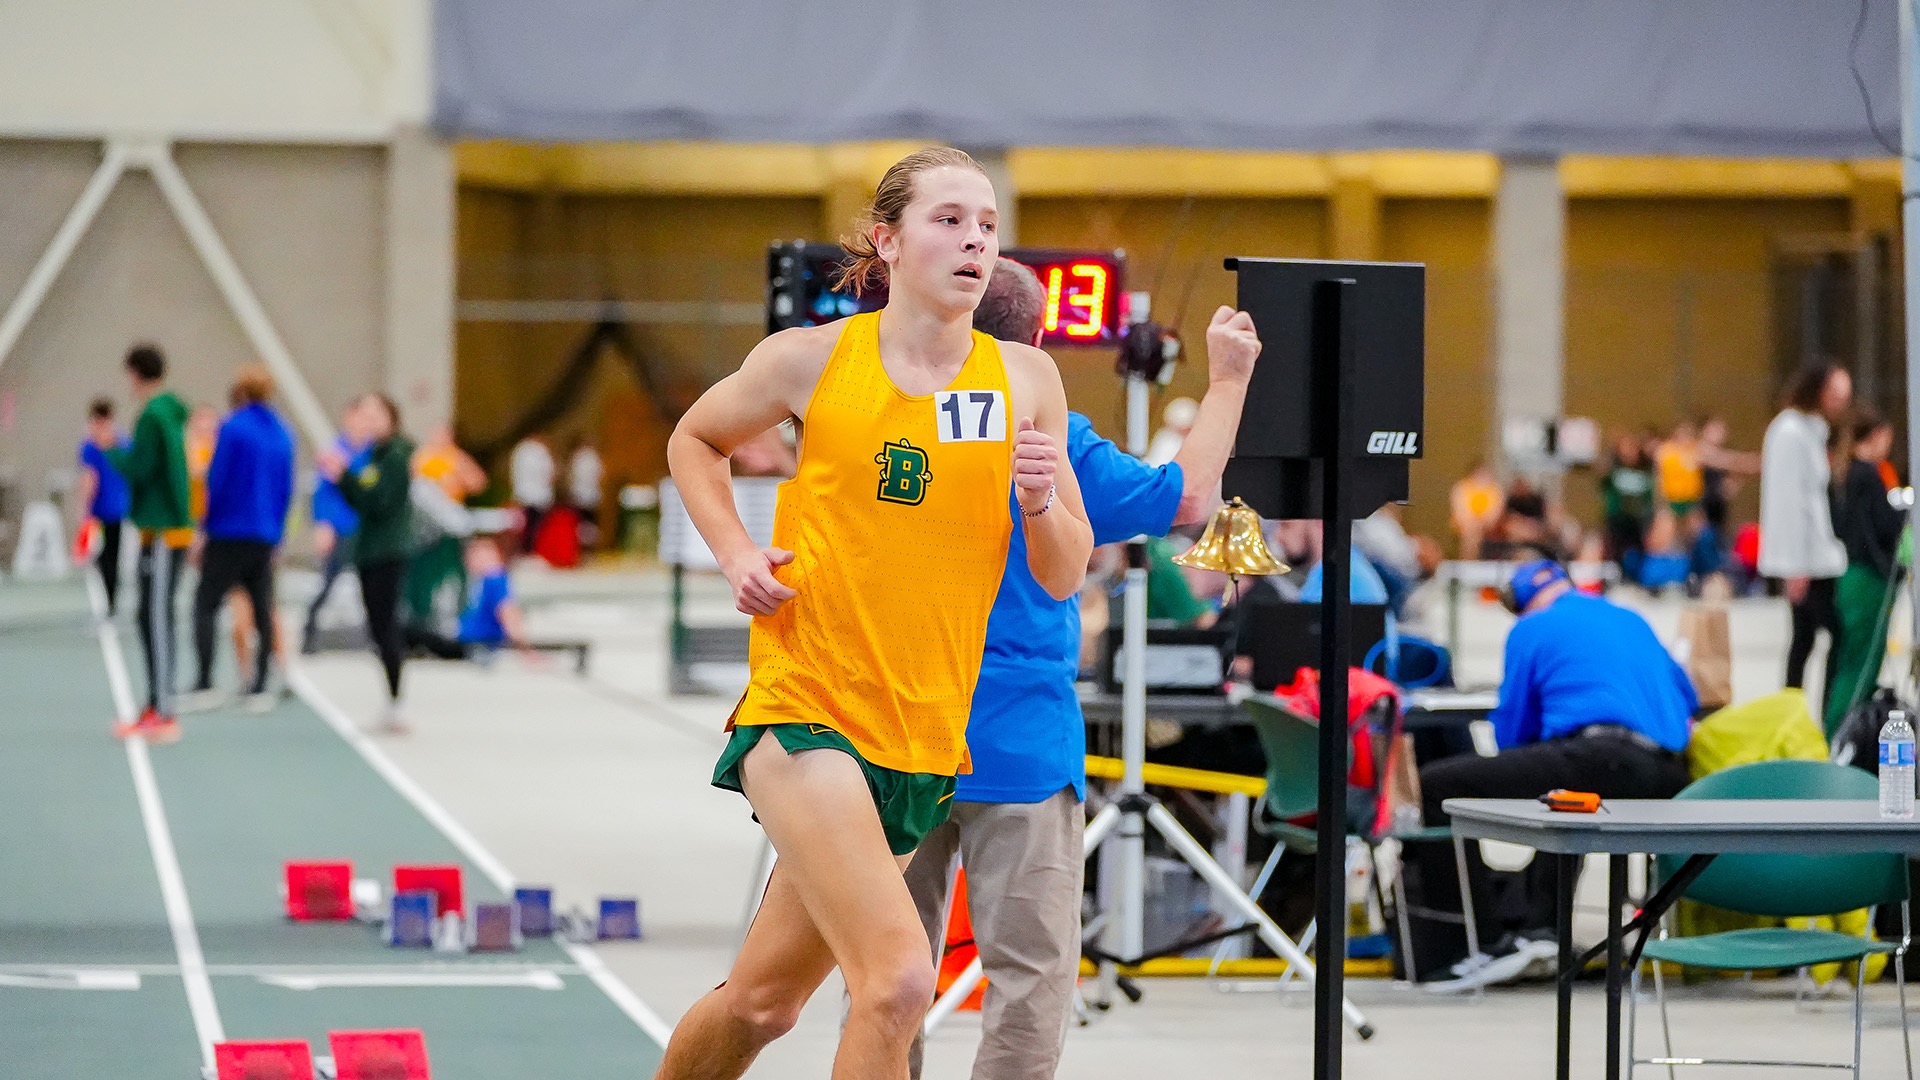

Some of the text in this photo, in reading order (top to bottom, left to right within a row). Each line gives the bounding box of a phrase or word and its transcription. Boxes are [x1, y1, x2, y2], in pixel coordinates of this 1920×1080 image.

[1045, 264, 1106, 336] 13
[941, 392, 995, 439] 17
[1366, 431, 1418, 455] GILL
[875, 438, 933, 506] B
